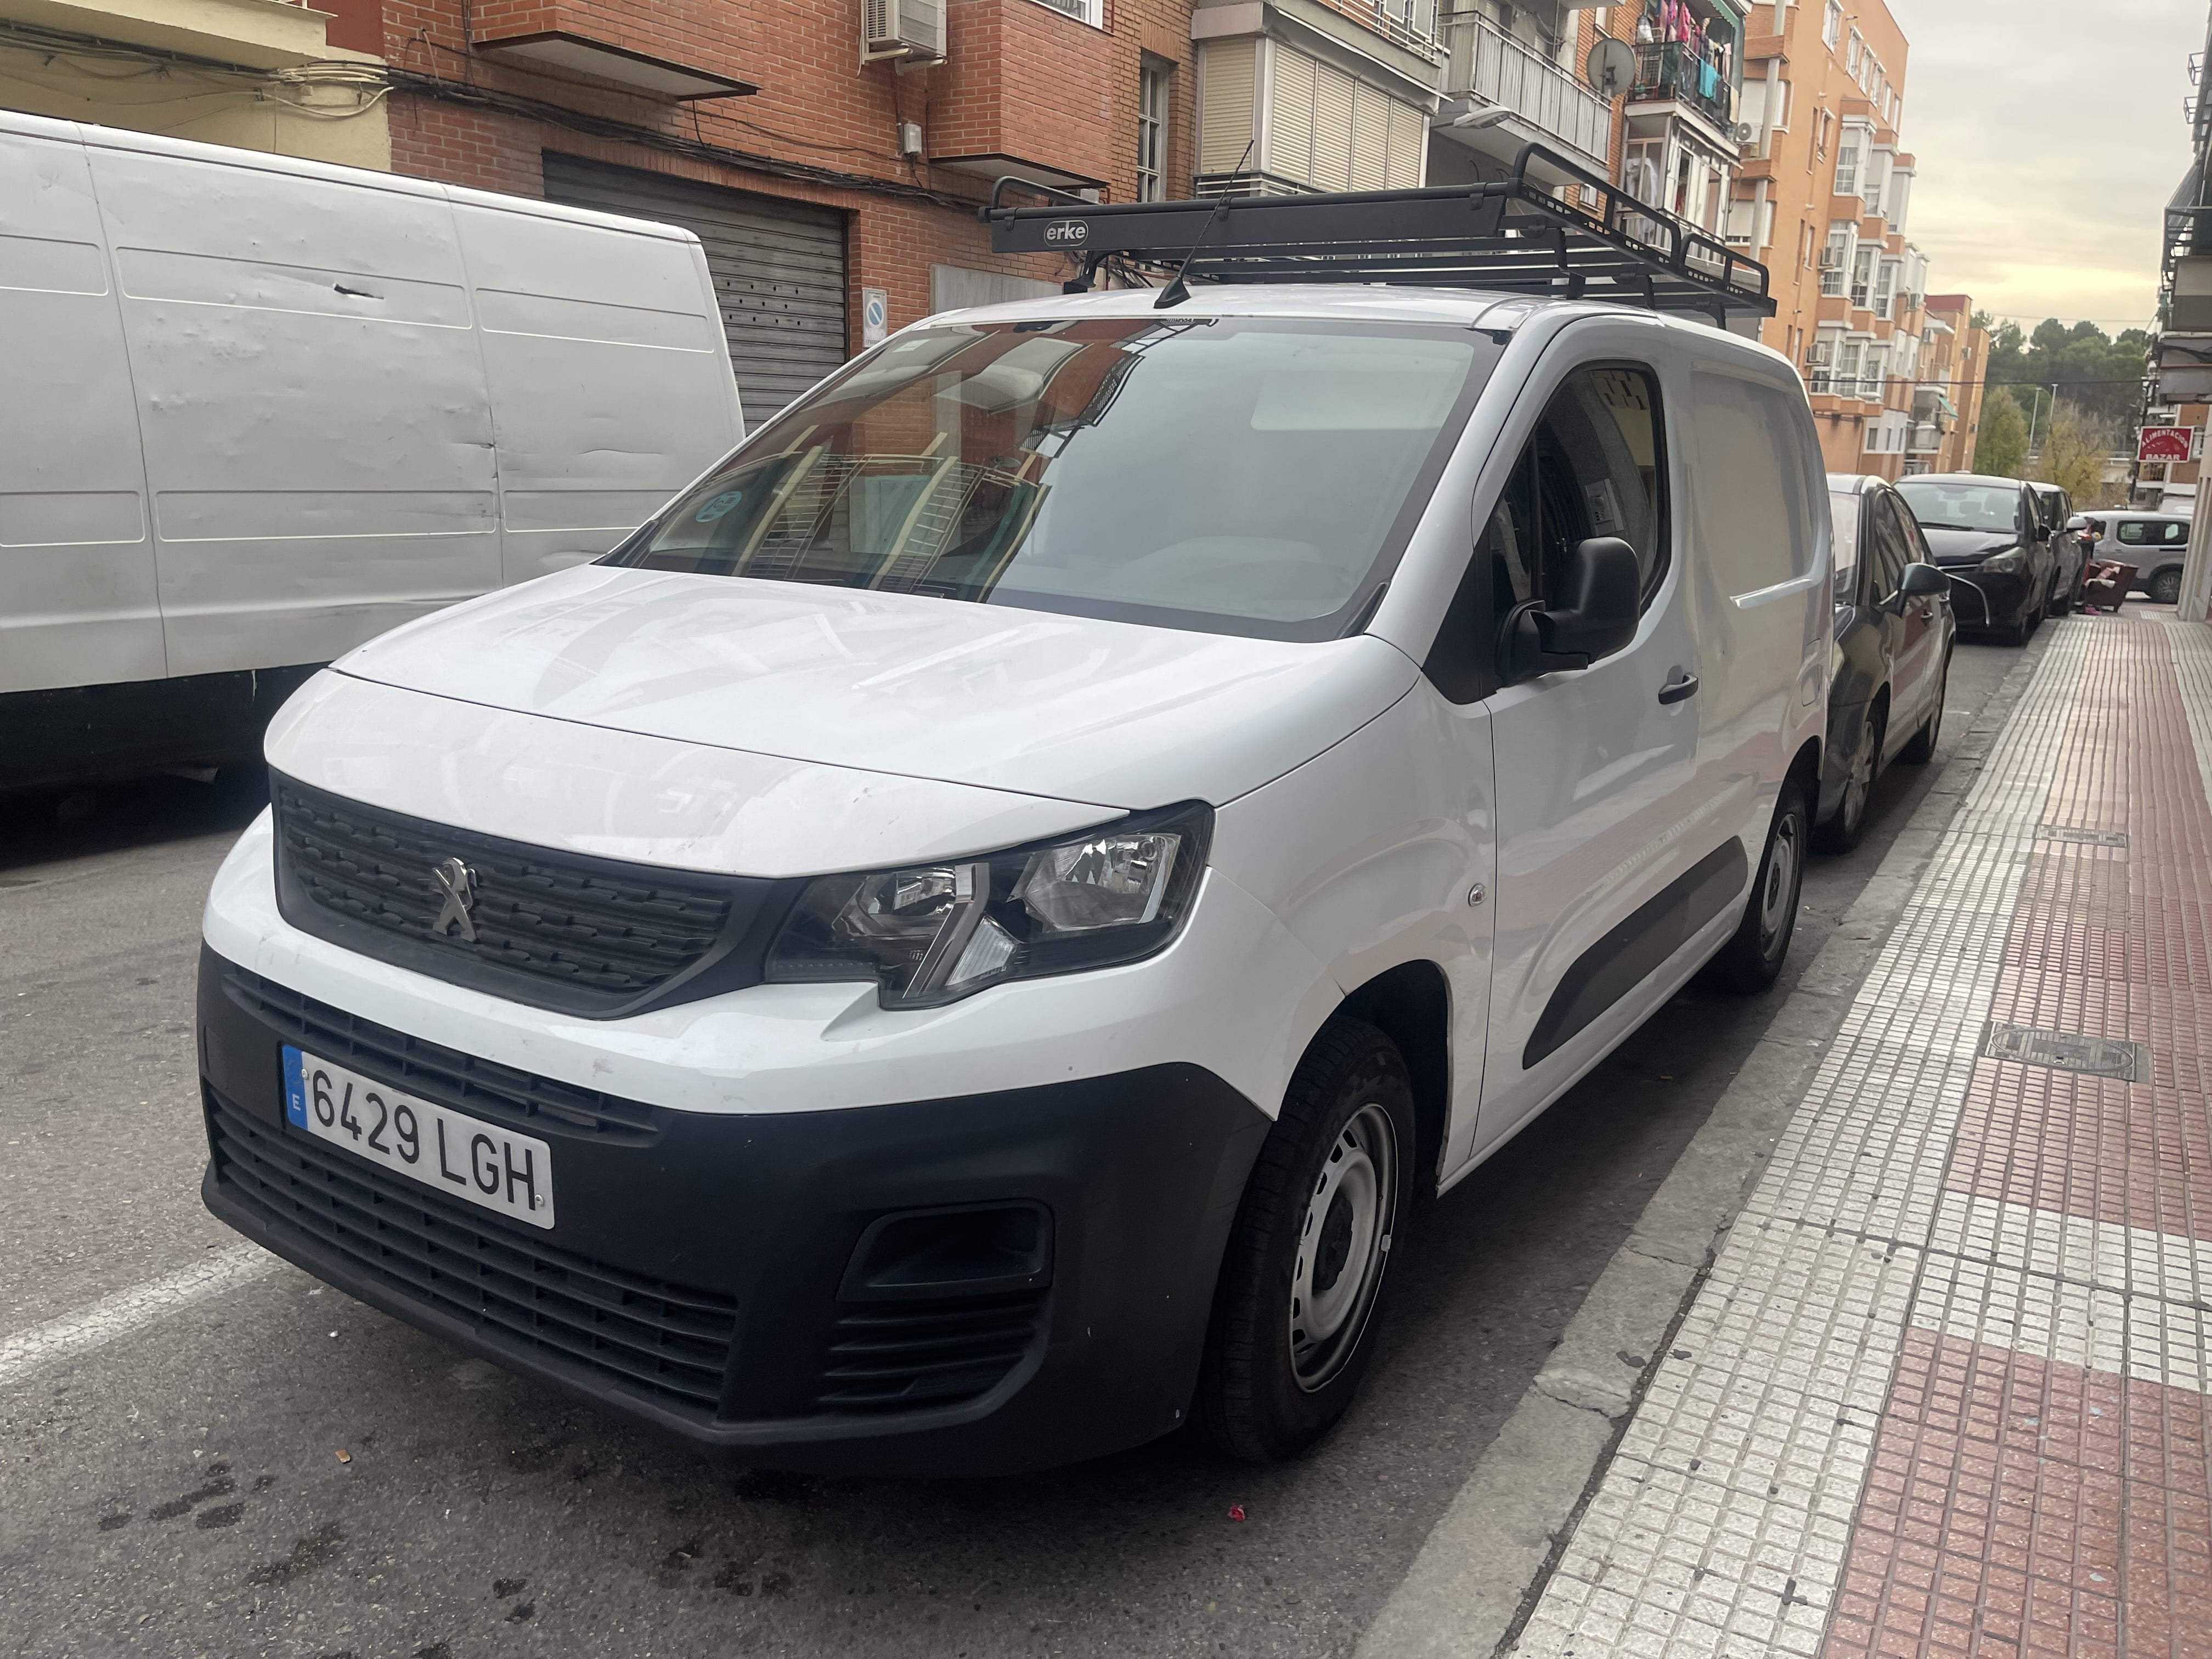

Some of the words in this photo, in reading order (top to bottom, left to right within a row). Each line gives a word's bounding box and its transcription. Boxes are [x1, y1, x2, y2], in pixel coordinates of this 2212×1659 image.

[1047, 221, 1085, 240] erke
[292, 1093, 301, 1111] E
[313, 1070, 420, 1164] 6429
[437, 1118, 535, 1211] LGH
